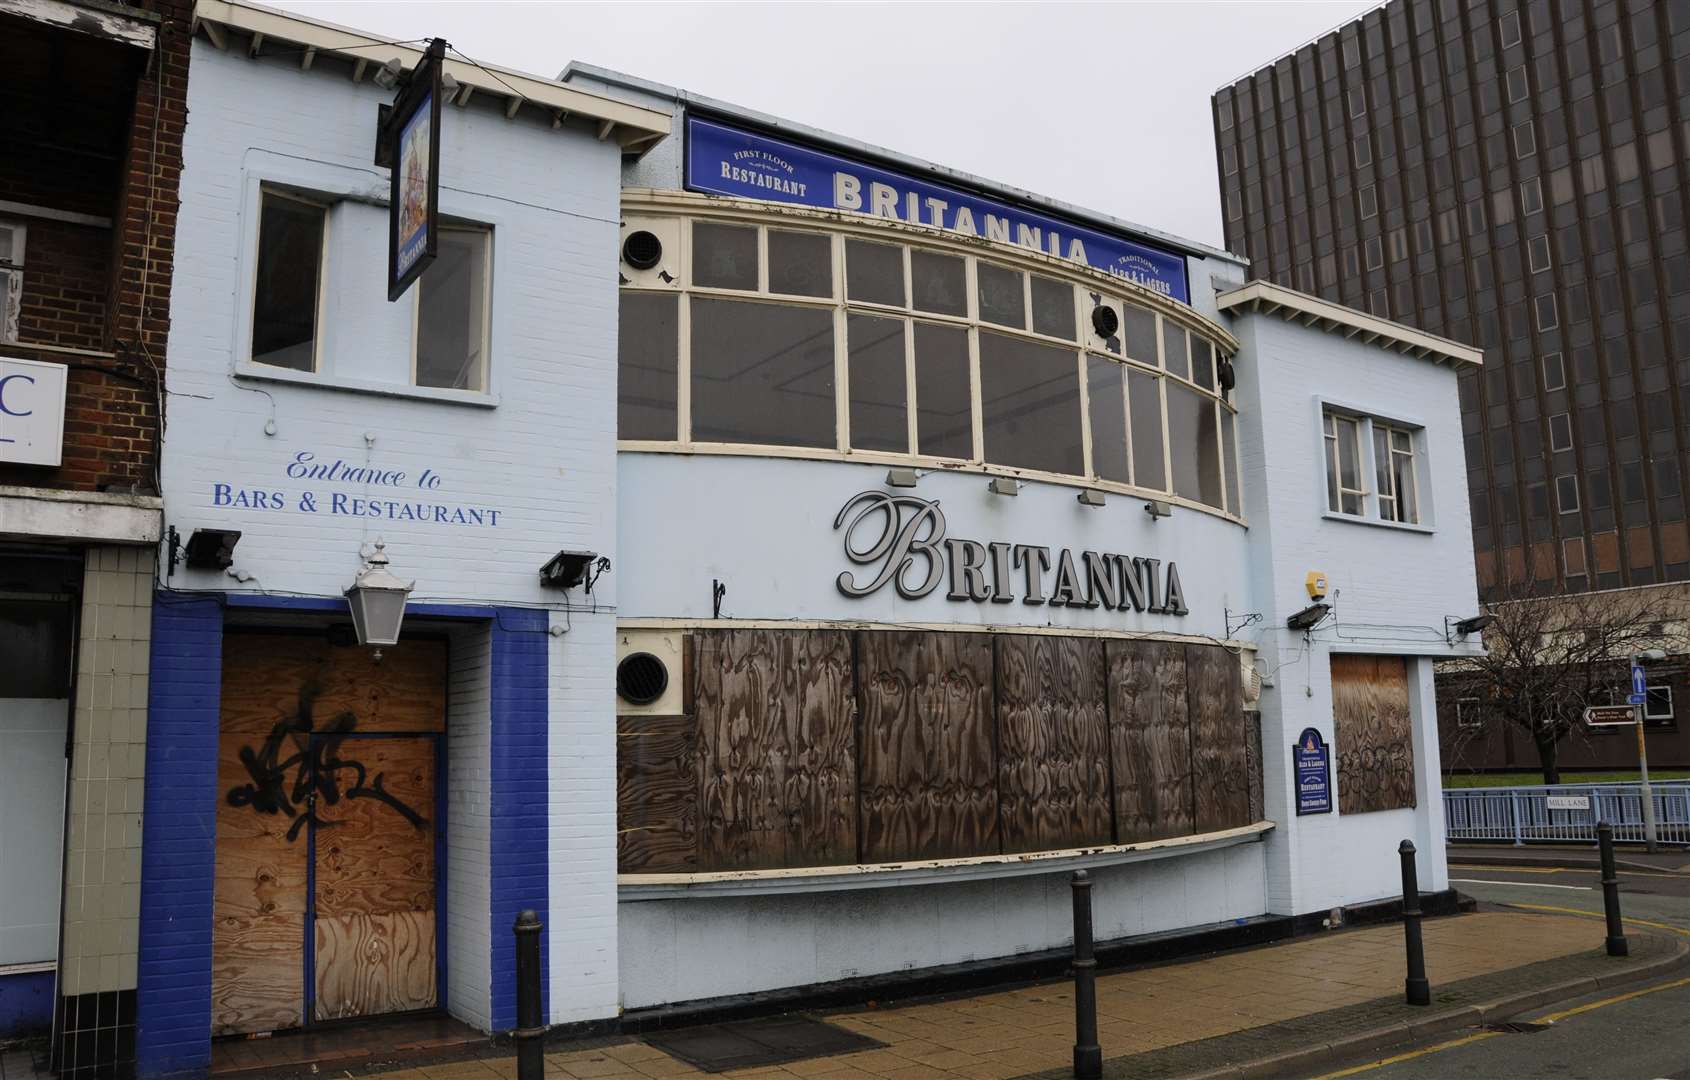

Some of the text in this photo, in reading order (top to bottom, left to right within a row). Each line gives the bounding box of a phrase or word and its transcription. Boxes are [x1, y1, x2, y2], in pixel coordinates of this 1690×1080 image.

[721, 161, 807, 197] RESTAURANT
[734, 150, 794, 174] FIRST FLOOR
[833, 171, 1089, 266] BRITANNIA
[1118, 255, 1160, 275] TRADITIONAL
[1132, 270, 1138, 281] &
[1141, 272, 1171, 295] LAGERS
[286, 451, 441, 489] Entrance to
[213, 483, 501, 526] BARS & RESTAURANT
[833, 490, 1189, 616] BRITANNIA
[1549, 799, 1588, 808] MILL LANE
